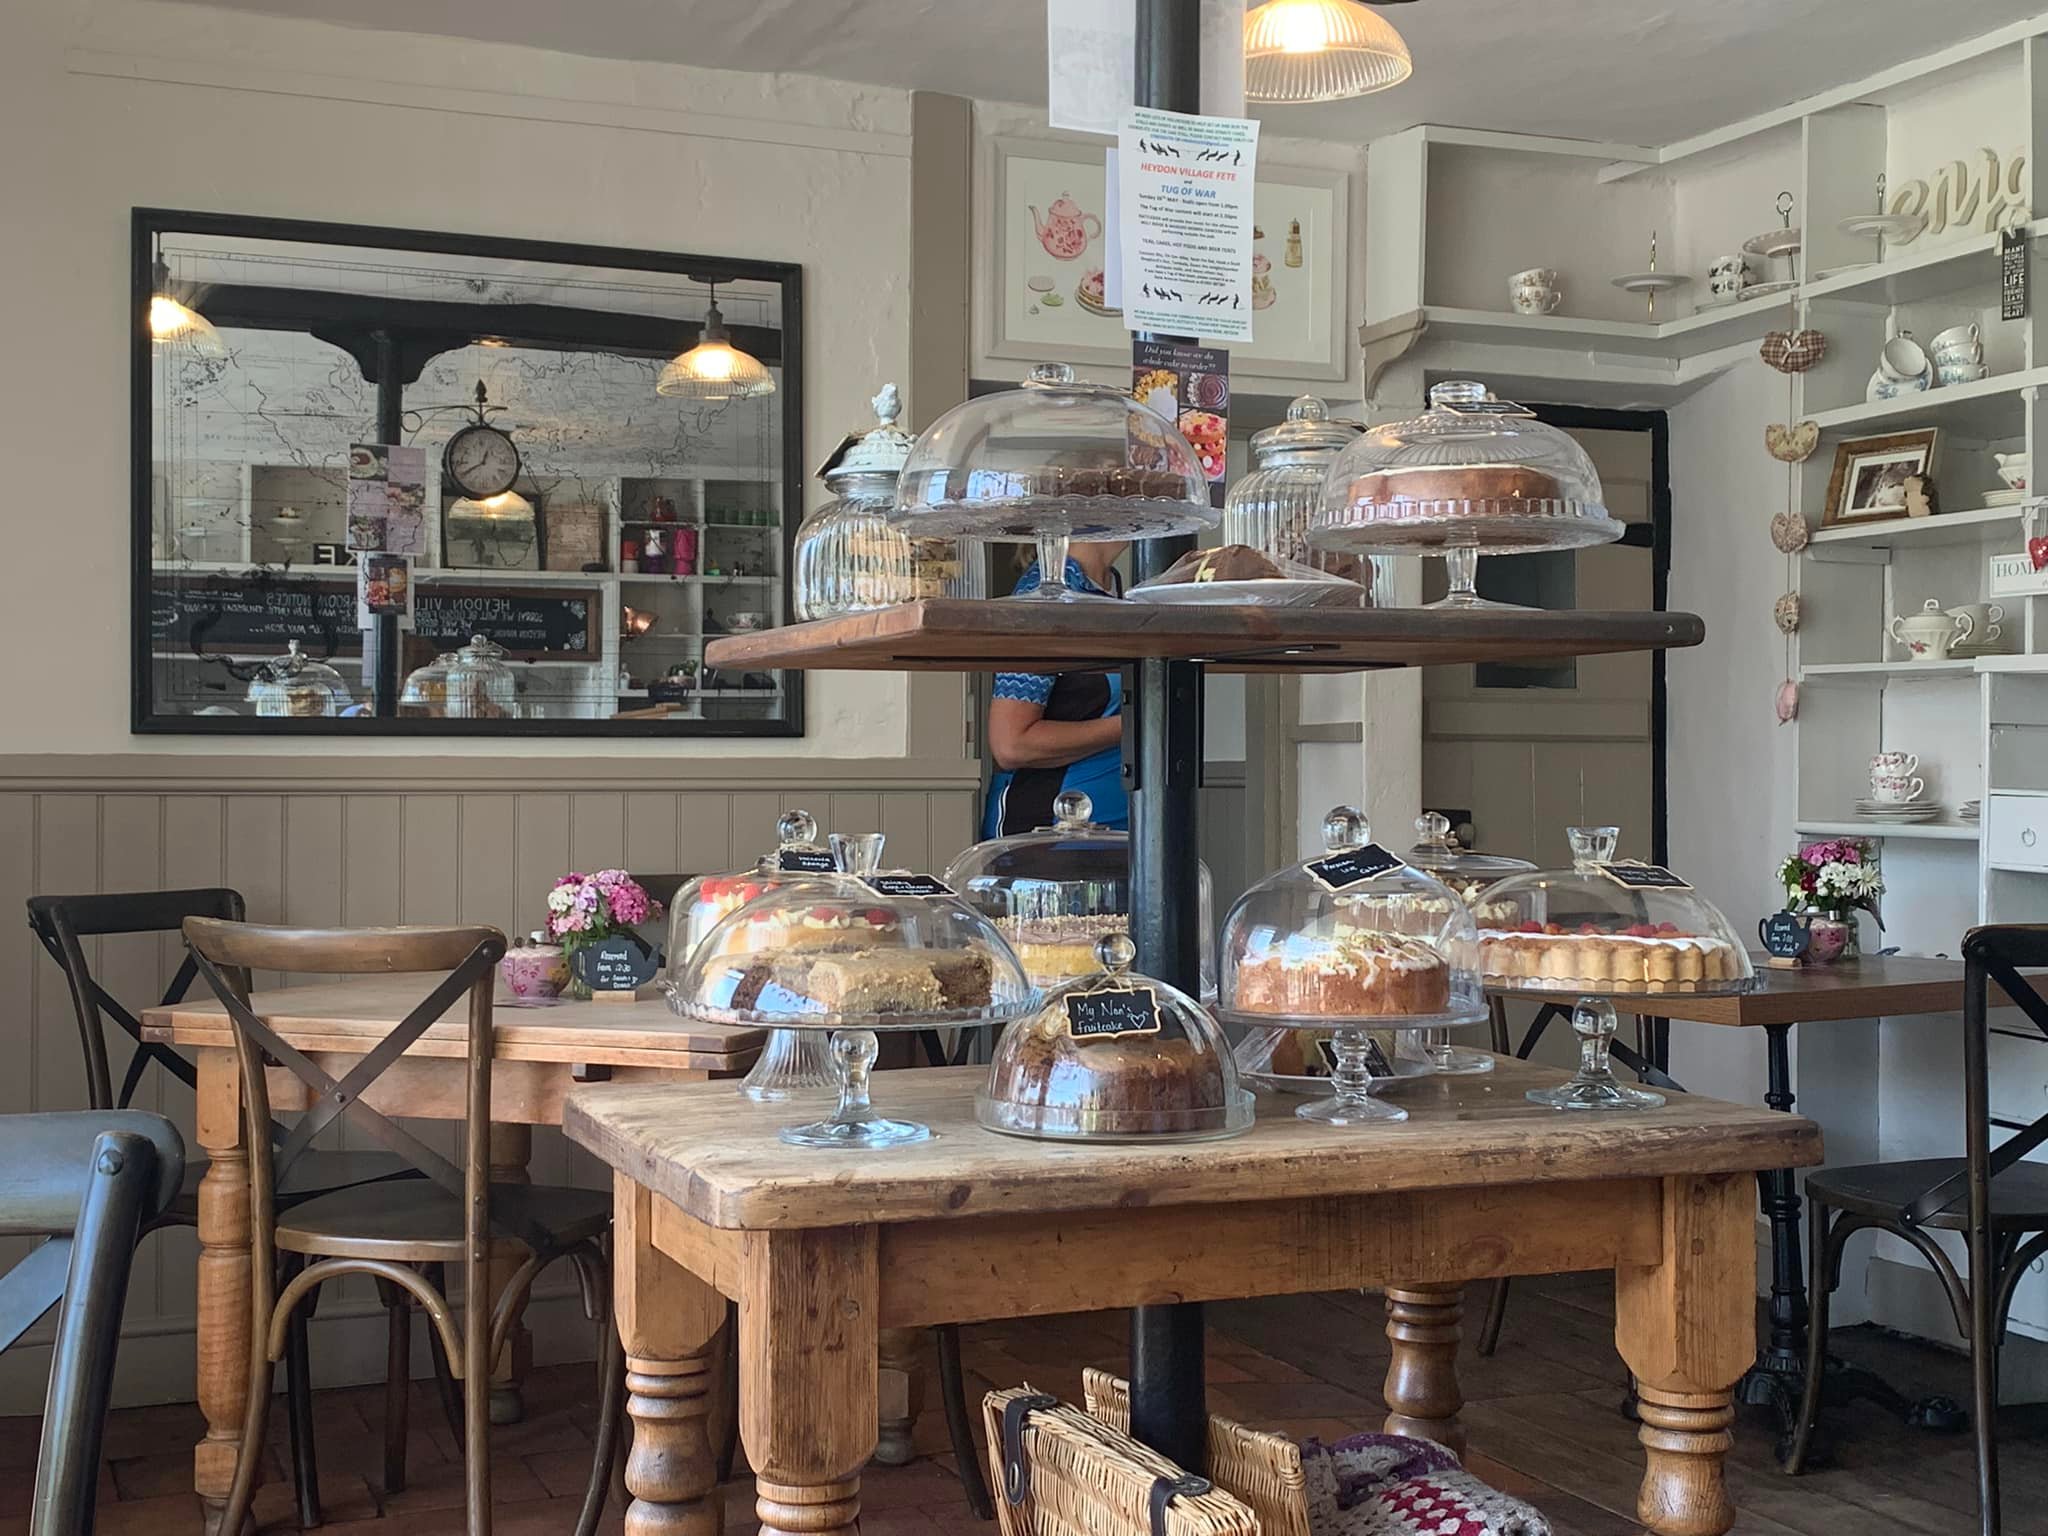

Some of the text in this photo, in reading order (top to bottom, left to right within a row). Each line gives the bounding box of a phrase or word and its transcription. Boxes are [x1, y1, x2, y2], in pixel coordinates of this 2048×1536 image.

[1141, 162, 1237, 181] HEYDON VILLAGE FETE
[1161, 185, 1217, 198] TUG OF WAR
[2004, 244, 2025, 254] MANY
[2004, 273, 2025, 286] LIFE
[1144, 344, 1159, 353] Did
[1159, 347, 1172, 356] you
[1173, 347, 1192, 358] know
[1203, 351, 1215, 360] do
[1996, 561, 2041, 577] HOM
[1077, 1002, 1095, 1021] My
[1077, 1020, 1124, 1034] fruitcake
